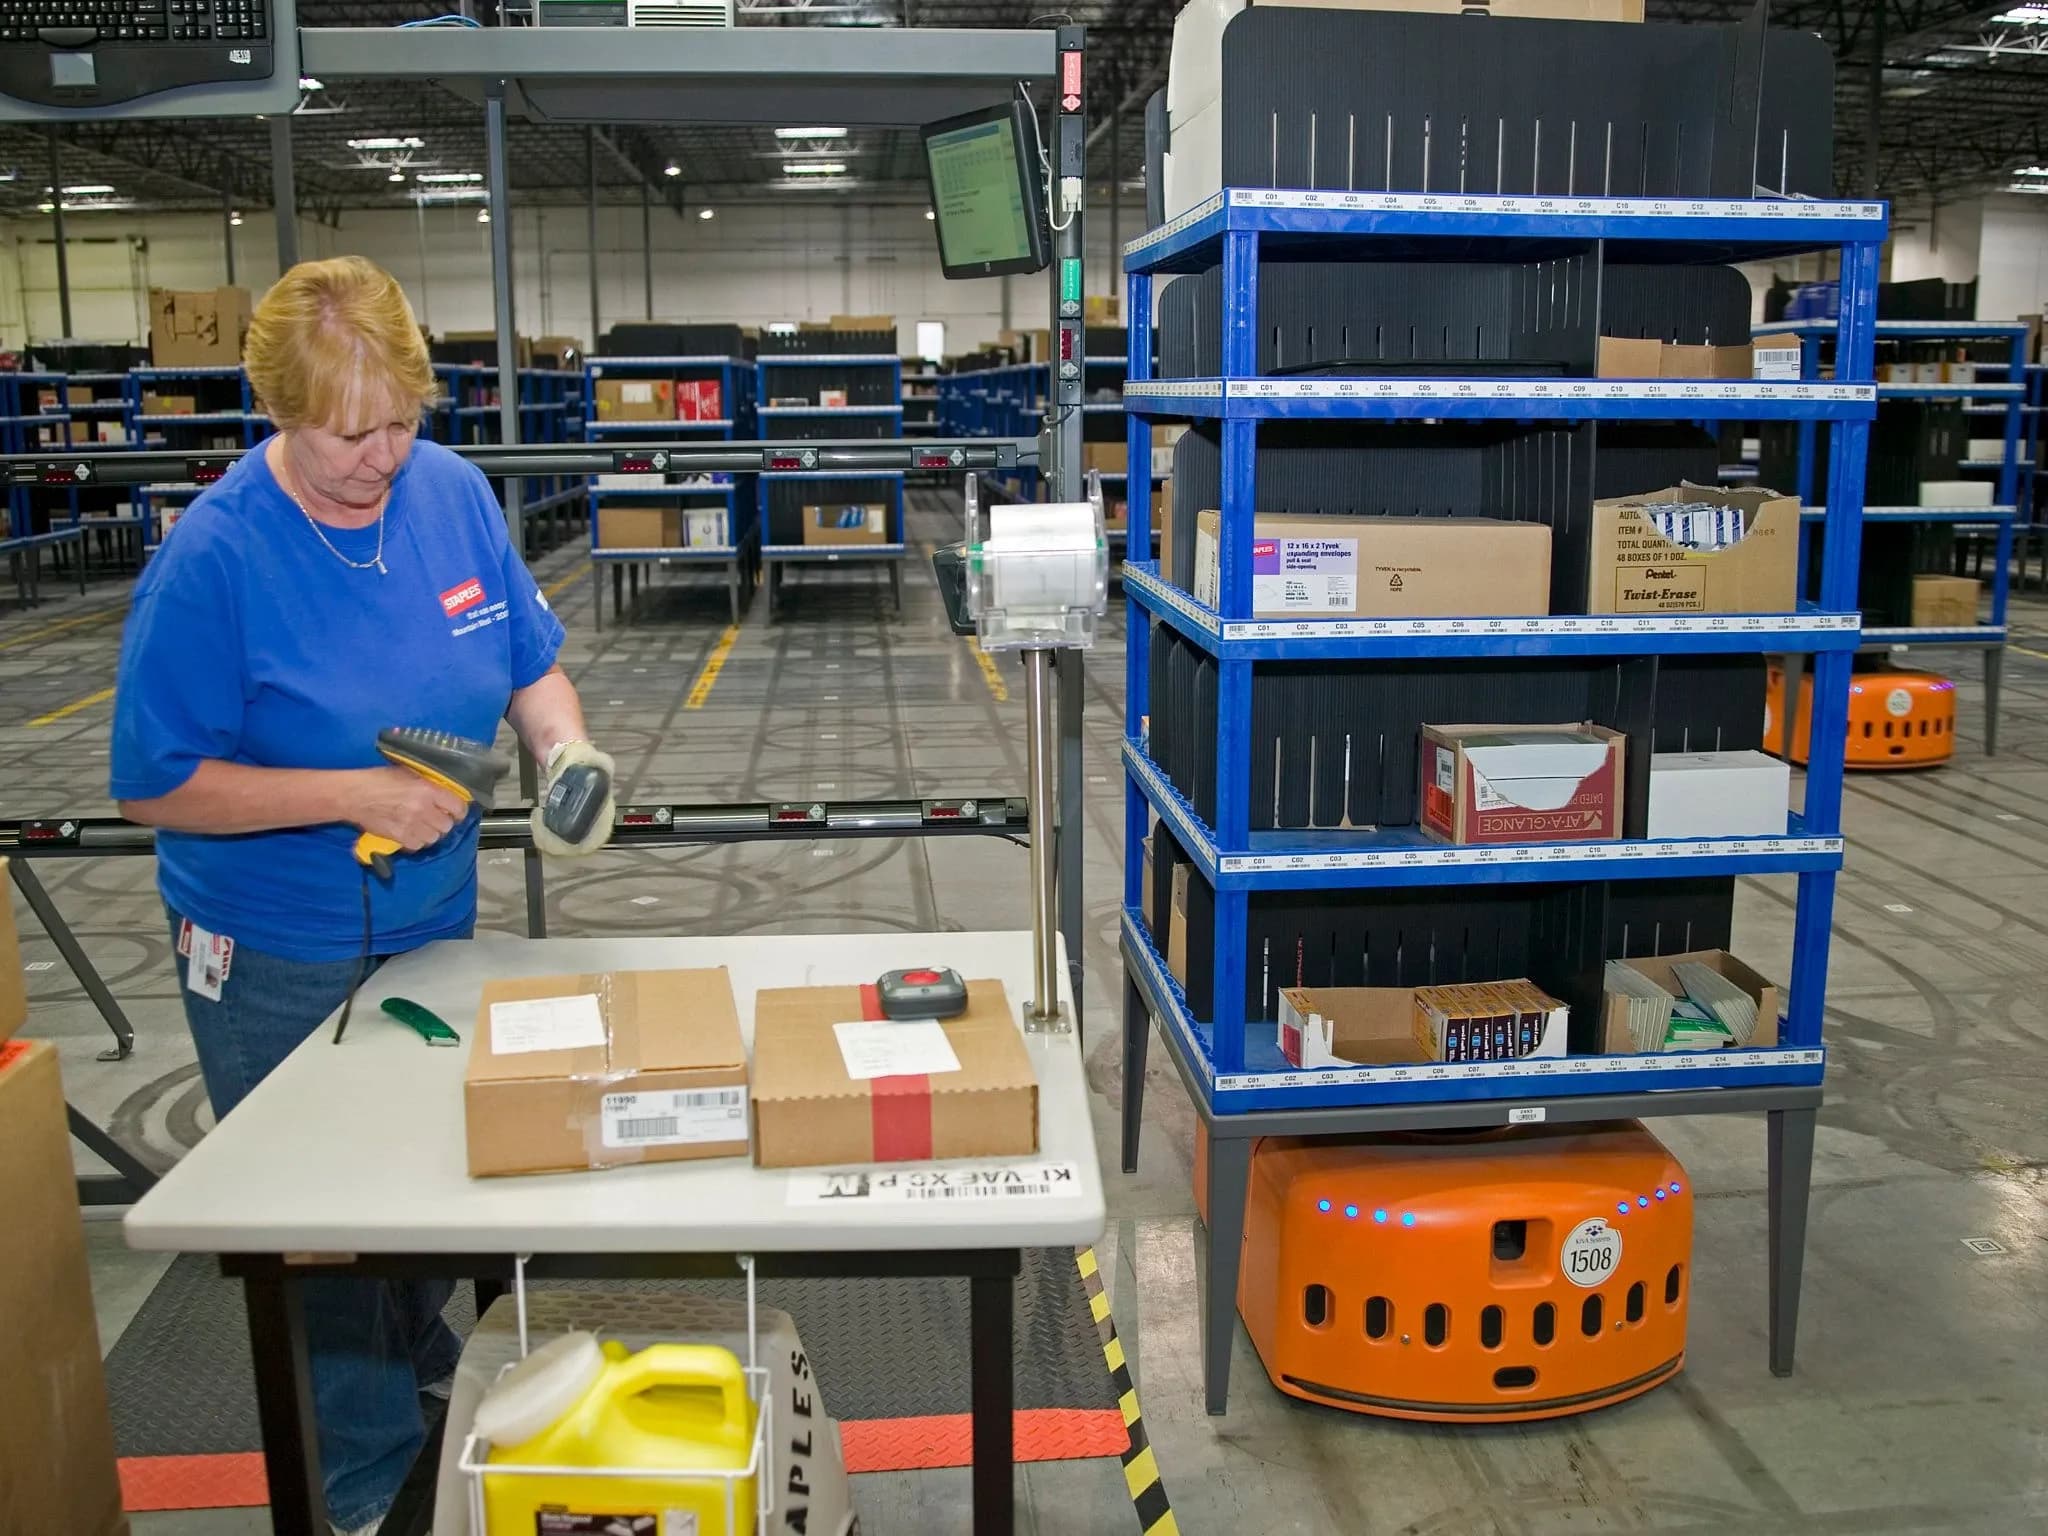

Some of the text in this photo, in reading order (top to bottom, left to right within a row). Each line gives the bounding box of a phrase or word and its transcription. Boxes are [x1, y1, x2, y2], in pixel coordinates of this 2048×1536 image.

[1618, 526, 1636, 535] ITEM
[1322, 542, 1340, 550] Tyvek
[1617, 540, 1640, 549] TOTAL
[1616, 553, 1626, 562] 48
[1627, 553, 1651, 562] BOXES
[1653, 553, 1663, 561] OF
[1645, 568, 1676, 579] Pentel
[444, 583, 481, 610] STAPLES
[1623, 588, 1697, 600] Twist-Erase
[1580, 793, 1603, 805] DATED
[1570, 1247, 1612, 1273] 1508
